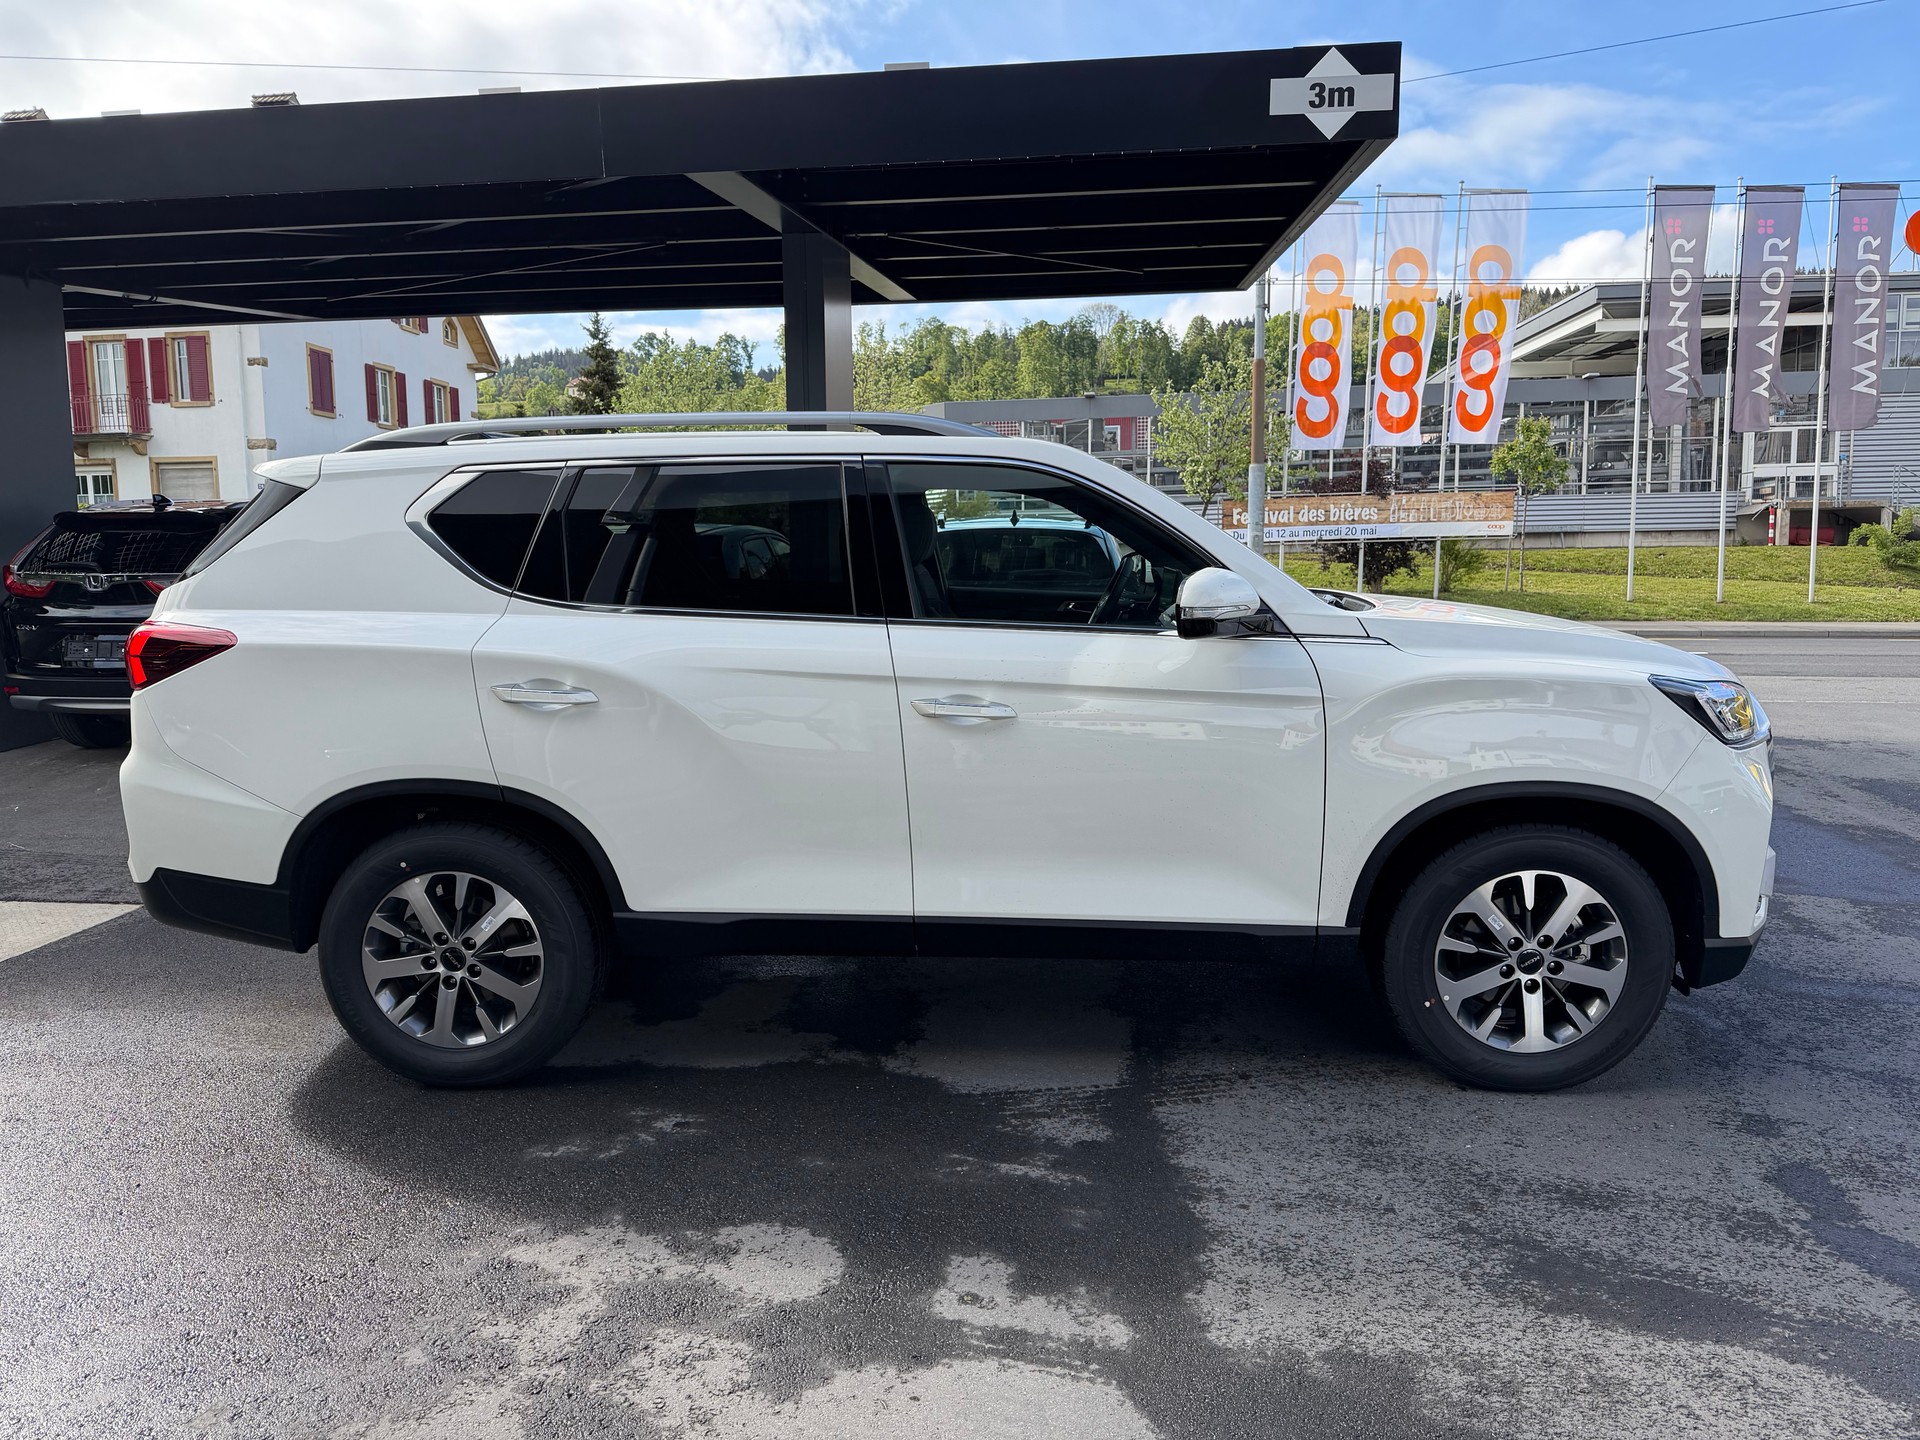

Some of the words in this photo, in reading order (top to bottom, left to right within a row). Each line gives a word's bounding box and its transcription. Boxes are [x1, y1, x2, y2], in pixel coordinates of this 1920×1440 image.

[1308, 82, 1355, 108] 3m
[1296, 253, 1354, 438] coop
[1376, 246, 1438, 434] coop
[1455, 244, 1522, 432] coop
[1665, 238, 1697, 395] MANOR
[1751, 236, 1791, 398] MANOR
[1850, 235, 1882, 396] MANOR
[1232, 505, 1294, 526] Feival
[1298, 504, 1326, 522] des
[1329, 502, 1378, 521] bières
[1232, 530, 1245, 540] Du
[1276, 528, 1286, 538] 12
[1289, 530, 1300, 538] au
[1302, 526, 1342, 537] mercredi
[1344, 526, 1358, 536] 20
[1360, 525, 1377, 536] mai
